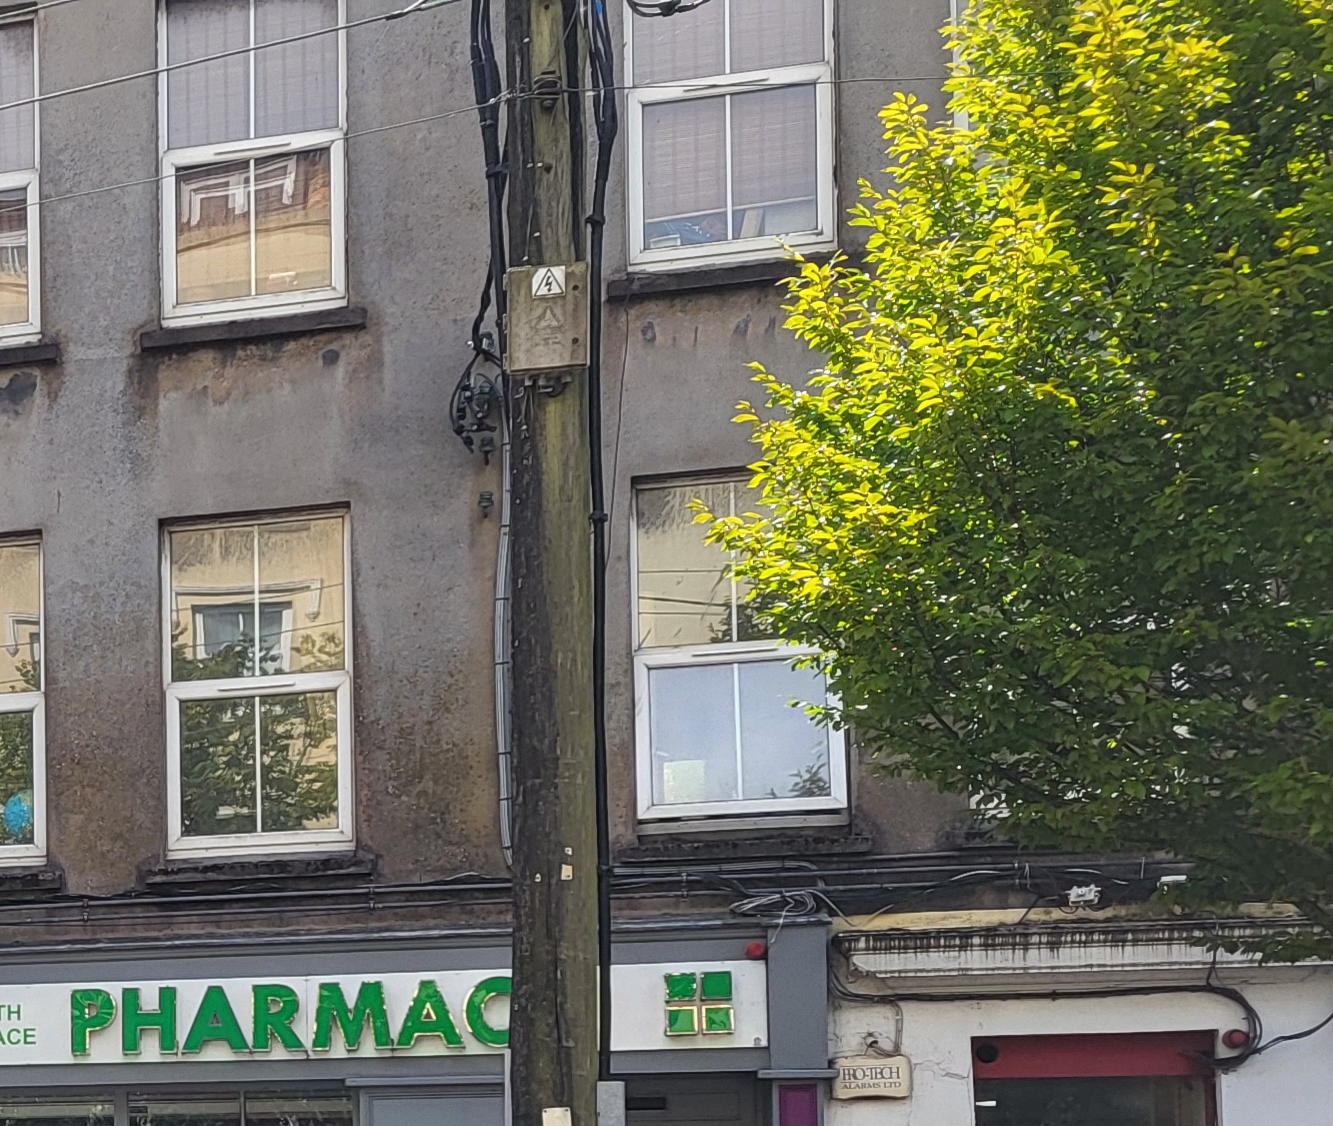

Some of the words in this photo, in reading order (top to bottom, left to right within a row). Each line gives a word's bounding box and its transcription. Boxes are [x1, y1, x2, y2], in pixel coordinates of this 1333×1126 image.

[71, 975, 512, 1056] PHARMAC
[841, 1066, 901, 1081] PRO-TECH
[841, 1082, 882, 1090] ALARMS
[883, 1081, 902, 1089] LTD
